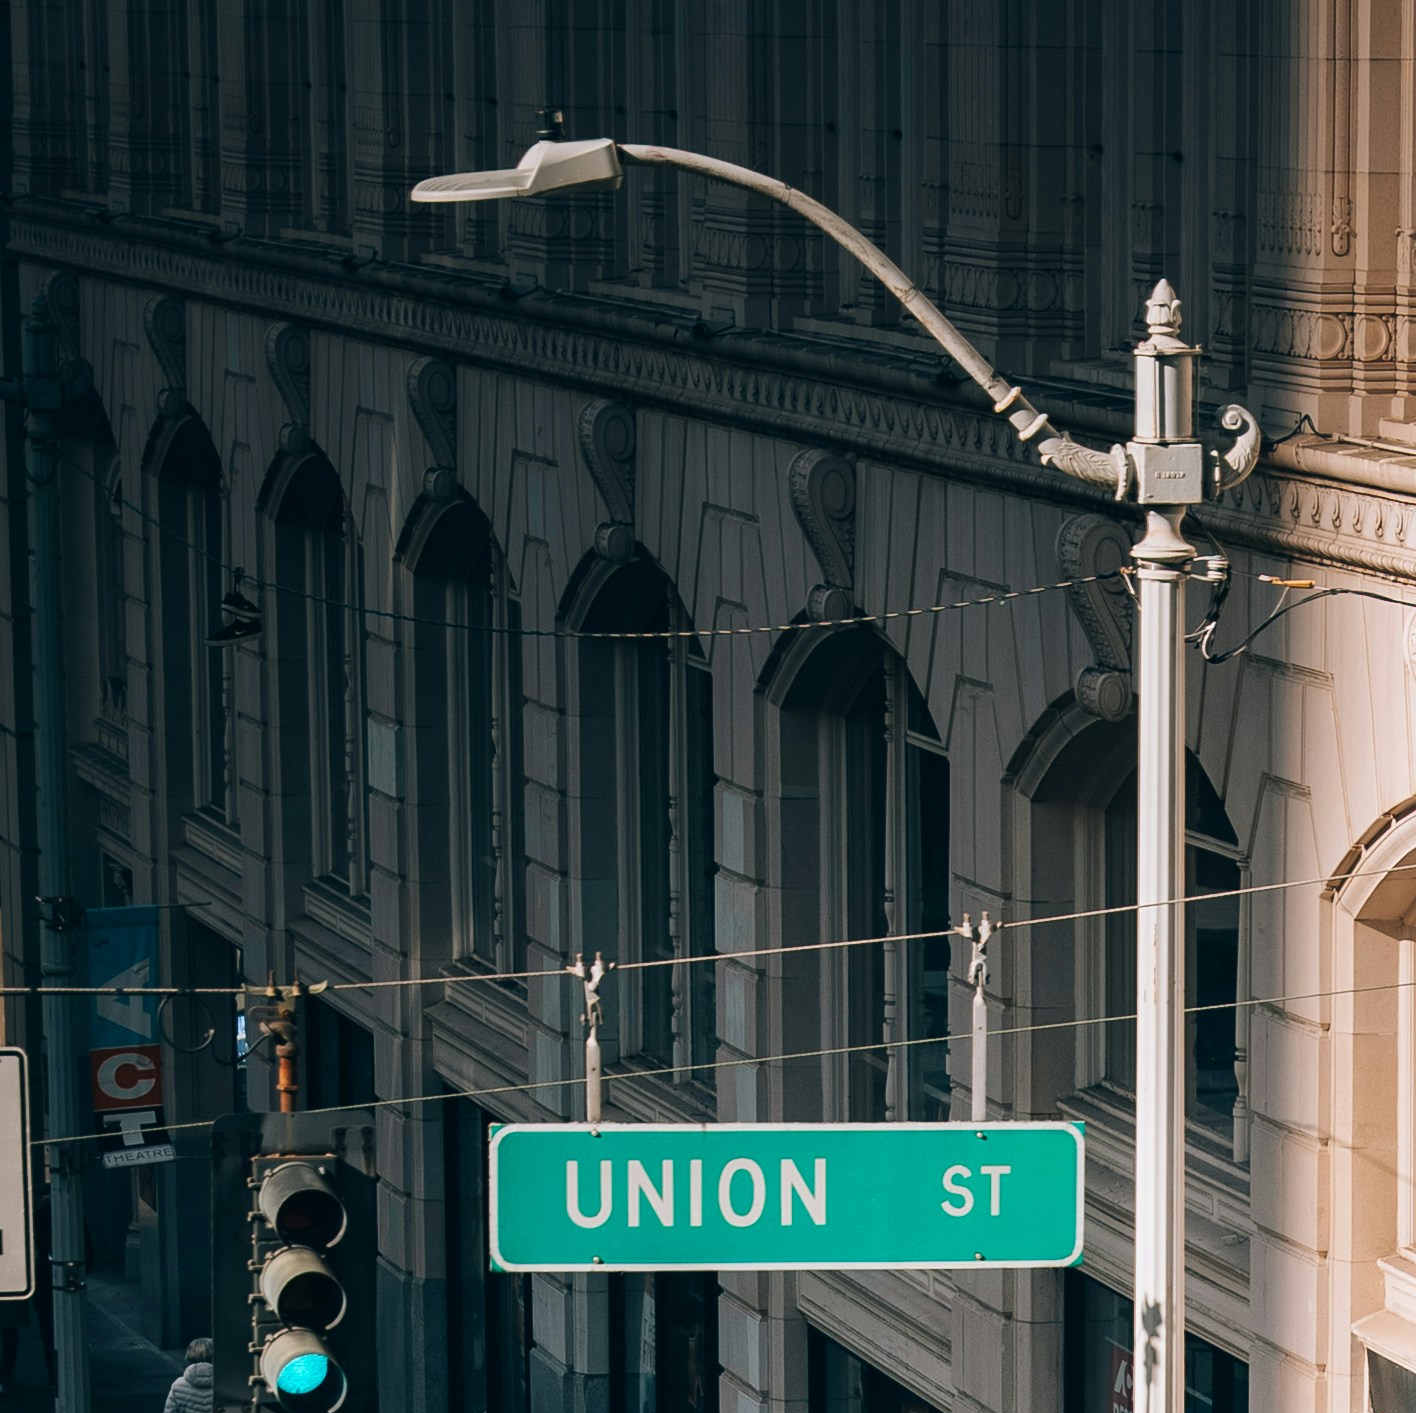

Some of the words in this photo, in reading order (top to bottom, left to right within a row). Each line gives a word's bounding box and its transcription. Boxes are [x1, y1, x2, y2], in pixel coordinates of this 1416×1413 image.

[105, 1147, 174, 1167] THEATRE
[566, 1157, 827, 1229] UNION
[941, 1164, 1012, 1217] ST
